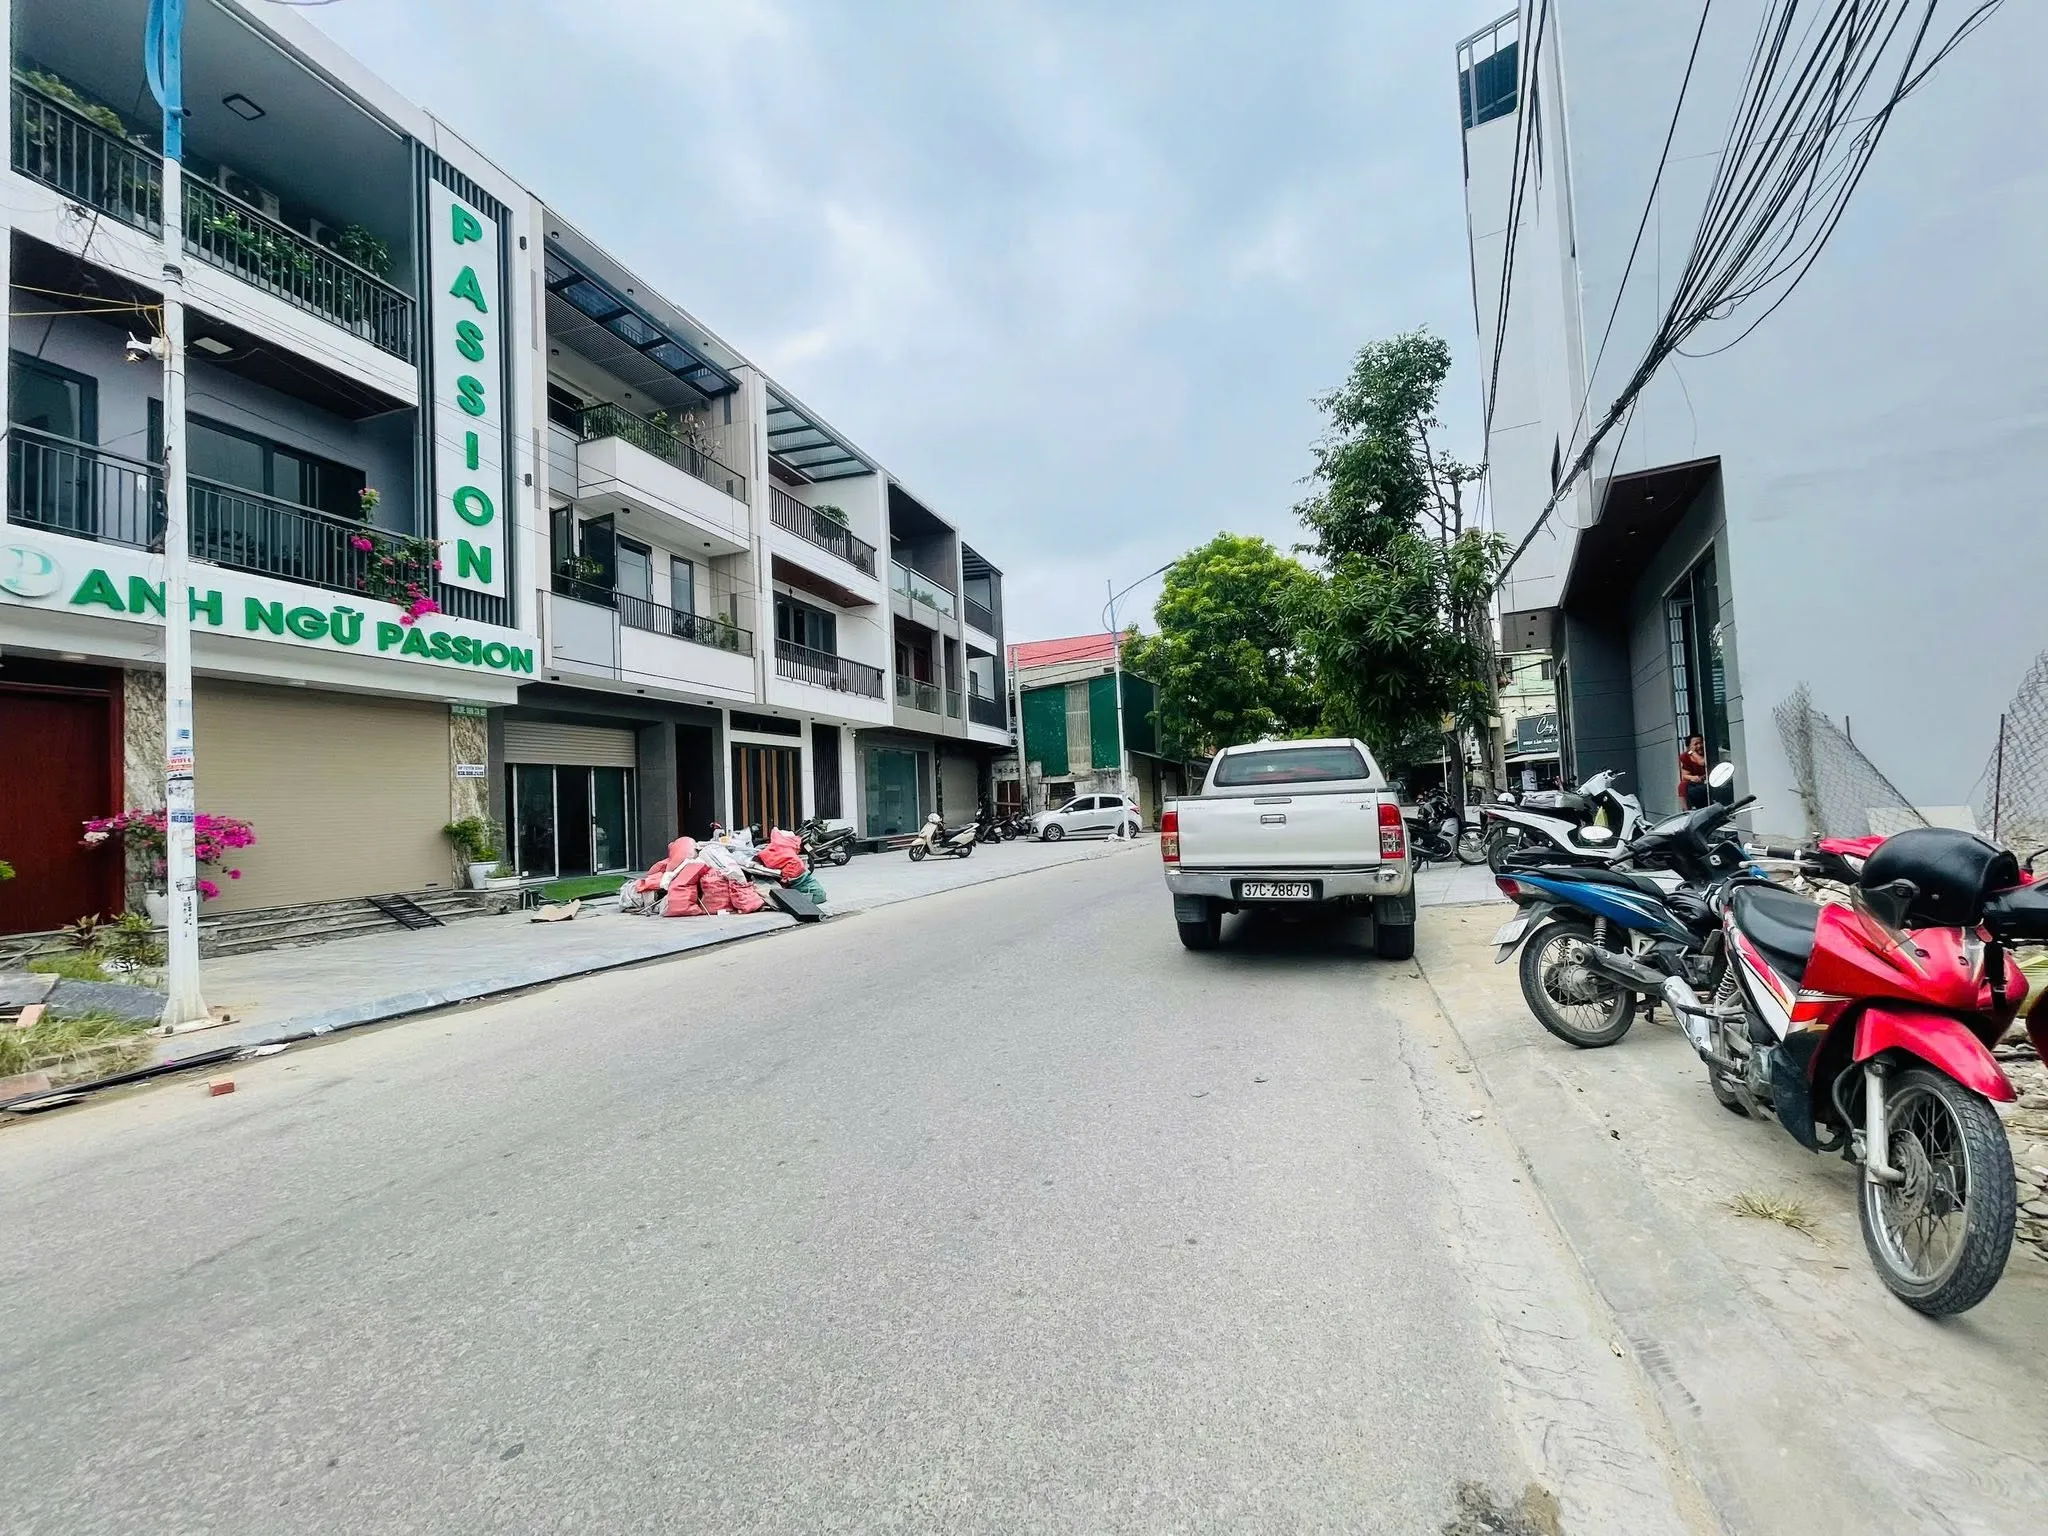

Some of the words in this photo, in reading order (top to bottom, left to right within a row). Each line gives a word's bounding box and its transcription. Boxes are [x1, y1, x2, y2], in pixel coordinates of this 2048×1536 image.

[449, 203, 495, 585] PASSION
[71, 569, 223, 625] ANH
[244, 598, 364, 645] NGỮ
[377, 621, 534, 673] PASSION
